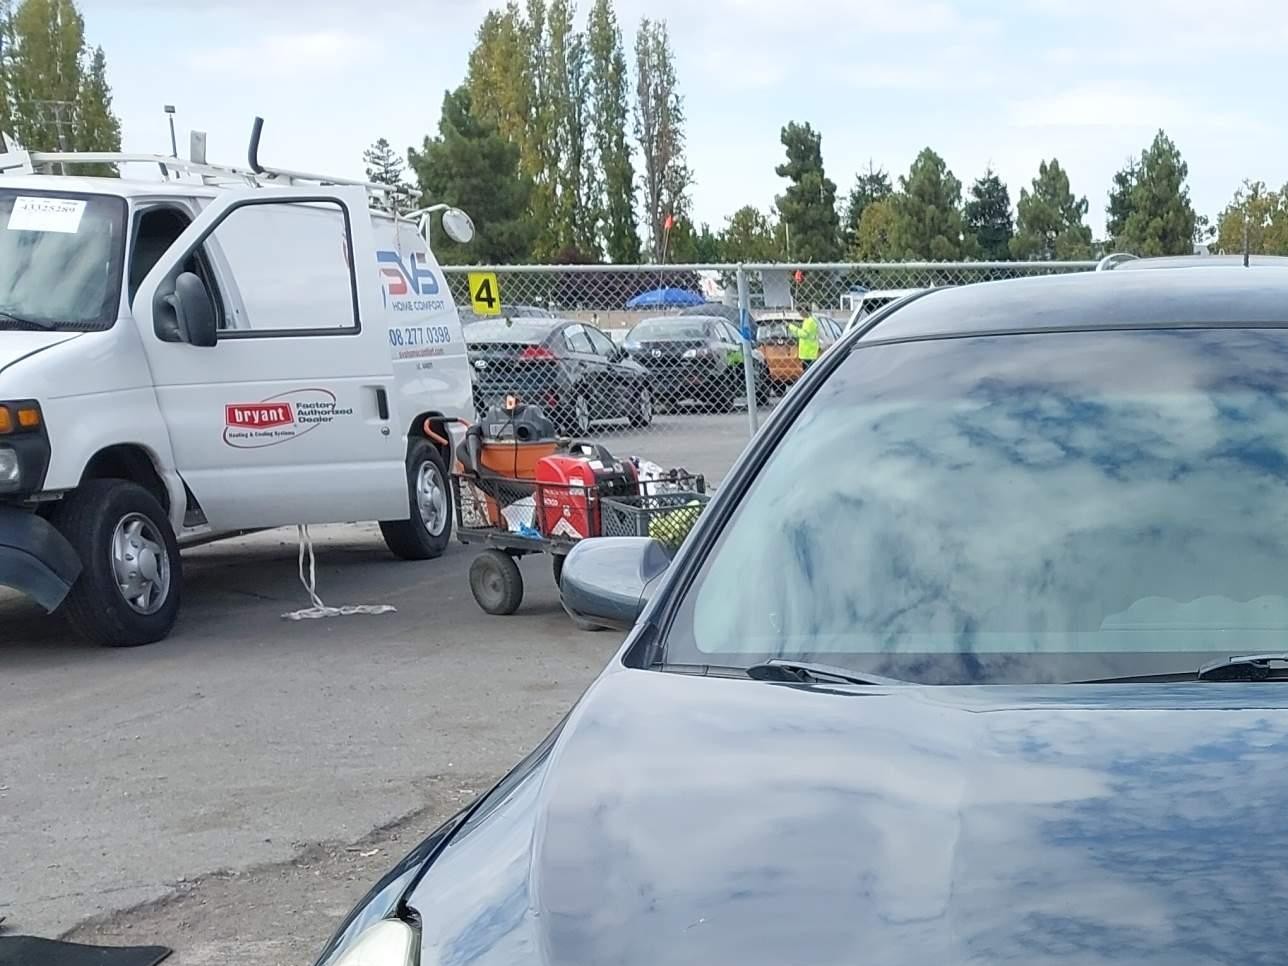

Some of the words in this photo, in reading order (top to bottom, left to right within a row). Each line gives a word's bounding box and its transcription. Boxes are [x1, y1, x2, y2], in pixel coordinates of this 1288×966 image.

[475, 278, 497, 309] 4
[392, 301, 413, 311] HOME
[414, 300, 445, 310] COMFORT
[389, 326, 451, 346] 08.277.0398
[296, 402, 336, 412] Factory
[297, 408, 353, 416] Authorized
[234, 408, 285, 424] bryant
